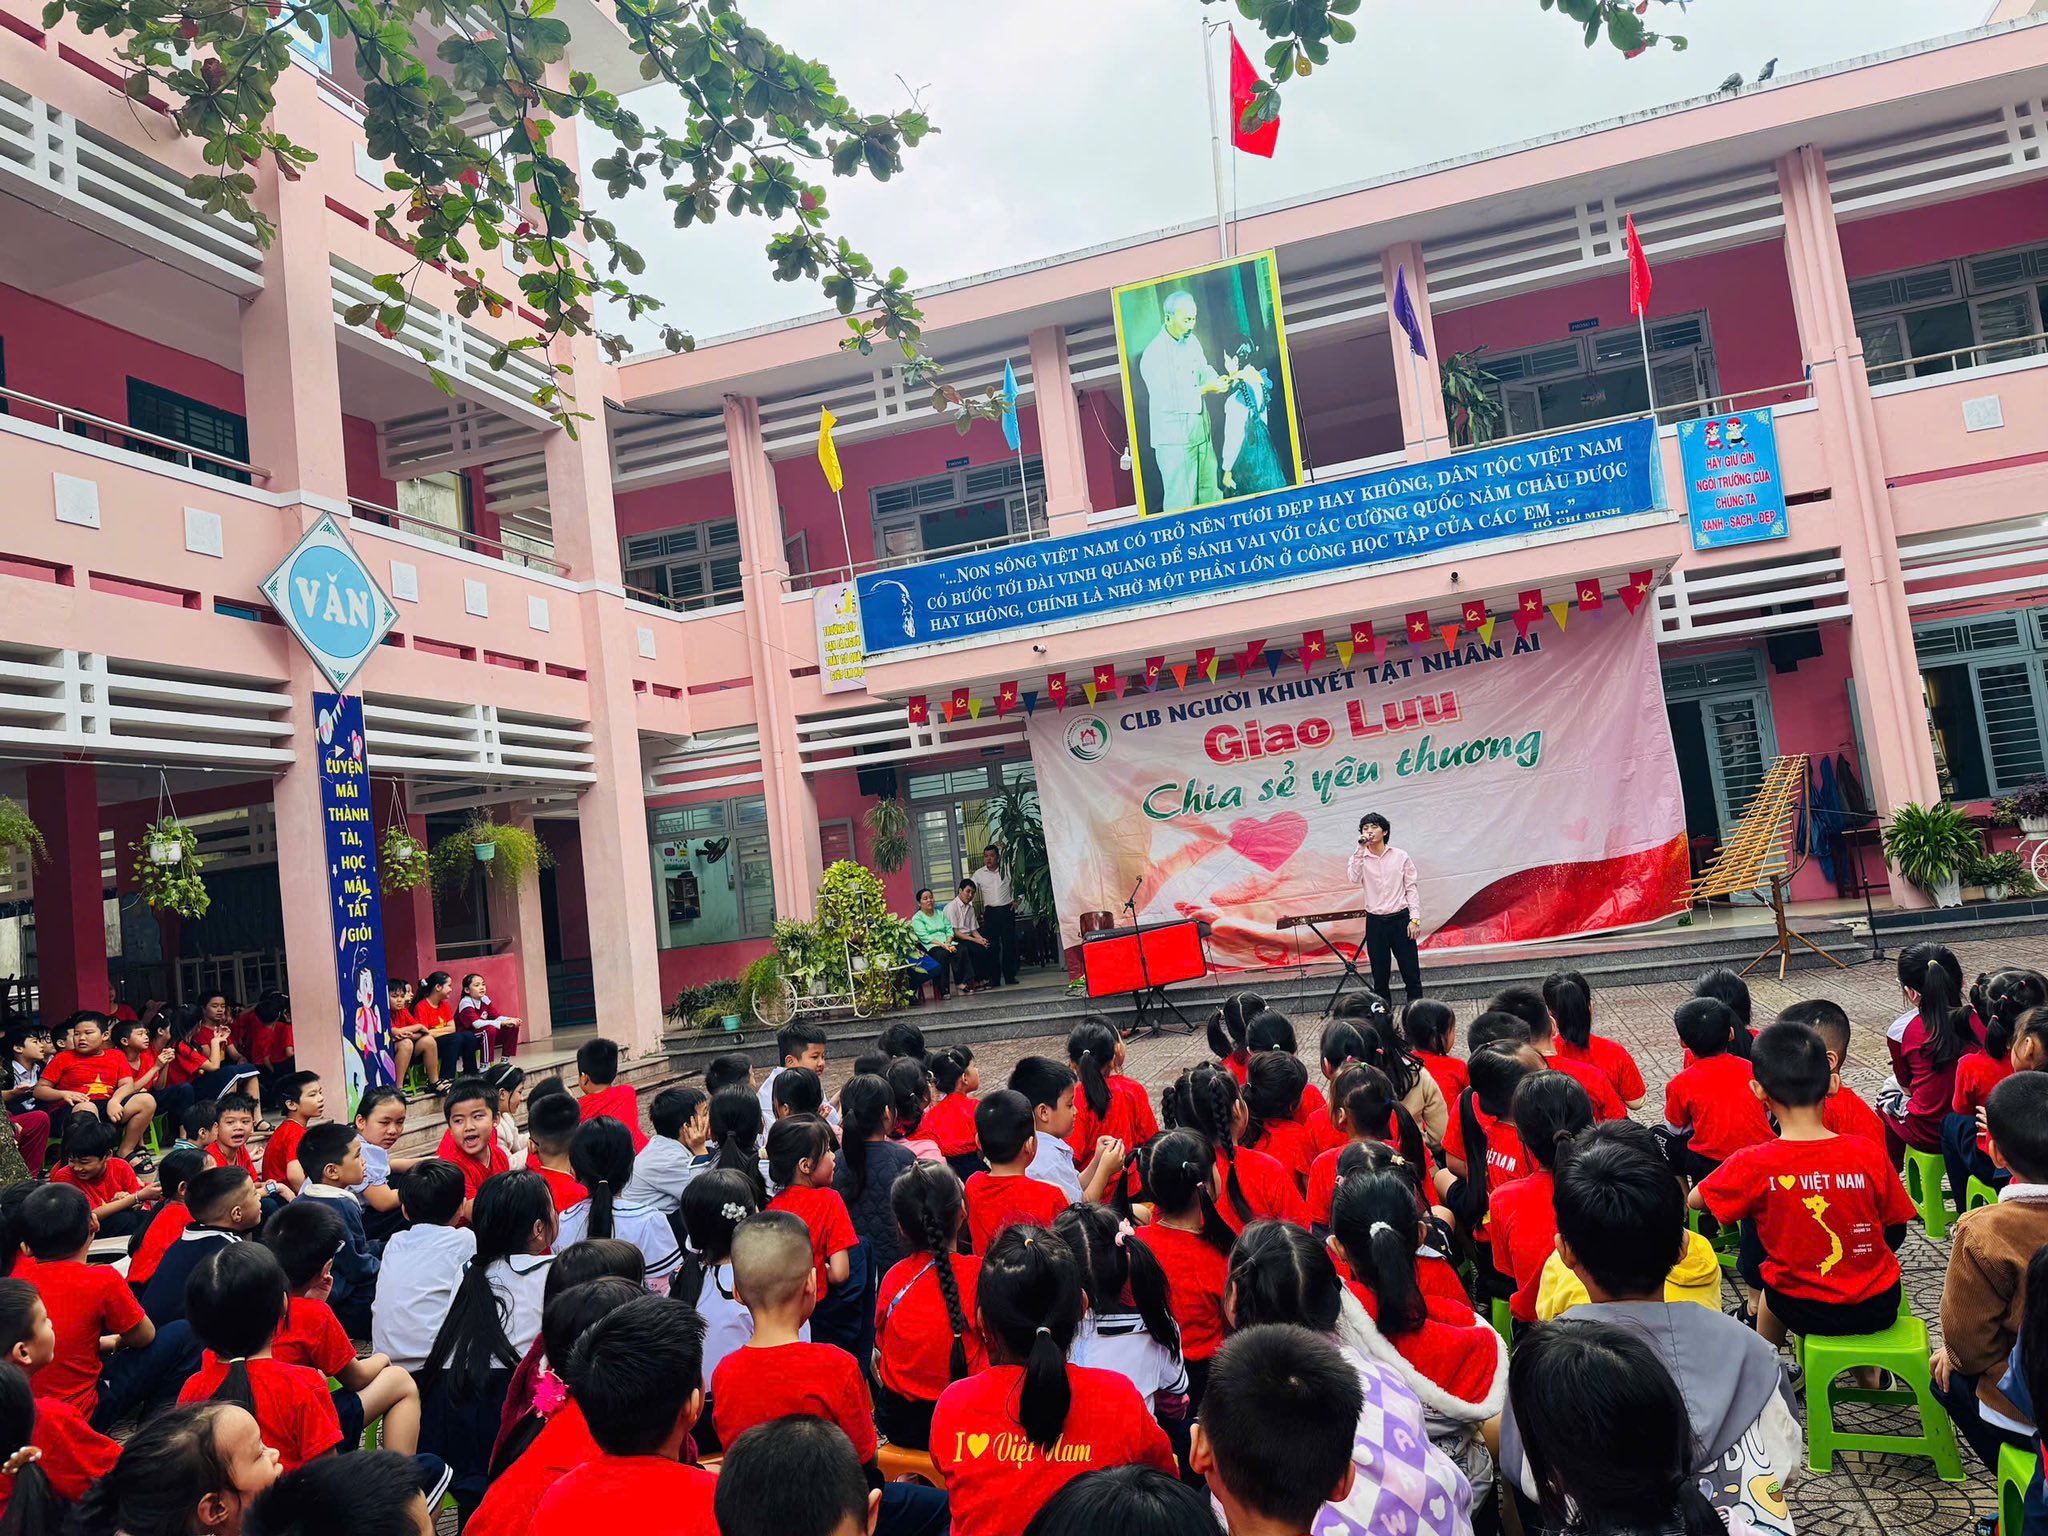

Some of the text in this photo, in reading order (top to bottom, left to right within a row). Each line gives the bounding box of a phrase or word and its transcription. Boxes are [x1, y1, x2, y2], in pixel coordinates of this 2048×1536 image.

[1696, 475, 1717, 491] NGÔI
[1753, 466, 1771, 483] CỦA
[994, 554, 1038, 575] SÔNG
[1040, 546, 1079, 566] VIỆT
[1082, 539, 1119, 559] NAM
[1123, 529, 1146, 550] CÓ
[1150, 520, 1185, 545] TRỞ
[1189, 516, 1226, 536] NÊN
[1230, 505, 1272, 528] TƯƠI
[1277, 498, 1314, 519] ĐẸP
[1319, 489, 1356, 511] HAY
[1360, 475, 1433, 502] KHÔNG,
[1437, 464, 1478, 486] DÂN
[1483, 455, 1522, 478] TỘC
[1527, 445, 1574, 468] VIỆT
[1578, 436, 1624, 458] NAM
[1715, 491, 1757, 509] CHÚNG TA
[1556, 513, 1581, 525] CHÍ
[1584, 507, 1622, 520] MINH
[1702, 519, 1724, 531] XANH
[1730, 515, 1753, 530] SẠCH
[1759, 511, 1776, 525] ĐẸP
[927, 461, 1629, 610] CÓ BƯỚC TỚI ĐÀI VINH QUANG ĐỂ SÁNH VAI VỚI CÁC CƯỜNG QUỐC NĂM CHÂU ĐƯỢC
[929, 614, 961, 632] HAY
[964, 604, 1024, 626] KHÔNG,
[1027, 594, 1079, 614] CHÍNH
[1083, 585, 1104, 605] LÀ
[1107, 575, 1144, 600] NHỜ
[1147, 572, 1186, 592] MỘT
[1189, 559, 1236, 584] PHẦN
[1240, 553, 1275, 574] LỚN
[1280, 548, 1292, 566] Ở
[1297, 543, 1347, 563] CÔNG
[1350, 534, 1389, 554] HỌC
[1393, 525, 1430, 546] TẬP
[1434, 513, 1474, 537] CỦA
[1478, 507, 1517, 529] CÁC
[1523, 503, 1551, 520] EM
[295, 568, 369, 629] VĂN
[1120, 709, 1162, 731] CLB
[1168, 689, 1251, 723] NGƯỜI
[1258, 667, 1356, 706] KHUYẾT
[1363, 659, 1413, 685] TẬT
[1421, 640, 1503, 674] NHÂN
[1203, 690, 1462, 765] Giao Lưu
[326, 757, 363, 777] LUYỆN
[1142, 730, 1542, 821] Chia sẻ yêu thương
[335, 781, 358, 797] MÃI
[328, 803, 369, 821] THÀNH
[340, 827, 363, 847] TÀI,
[341, 855, 366, 873] HỌC
[344, 875, 367, 893] MÃI
[347, 897, 368, 917] TẤT
[347, 922, 373, 942] GIỎI
[1495, 1152, 1517, 1172] NAM
[1769, 1171, 1865, 1192] I VIỆT NAM
[953, 1431, 965, 1462] I
[993, 1432, 1035, 1469] Việt
